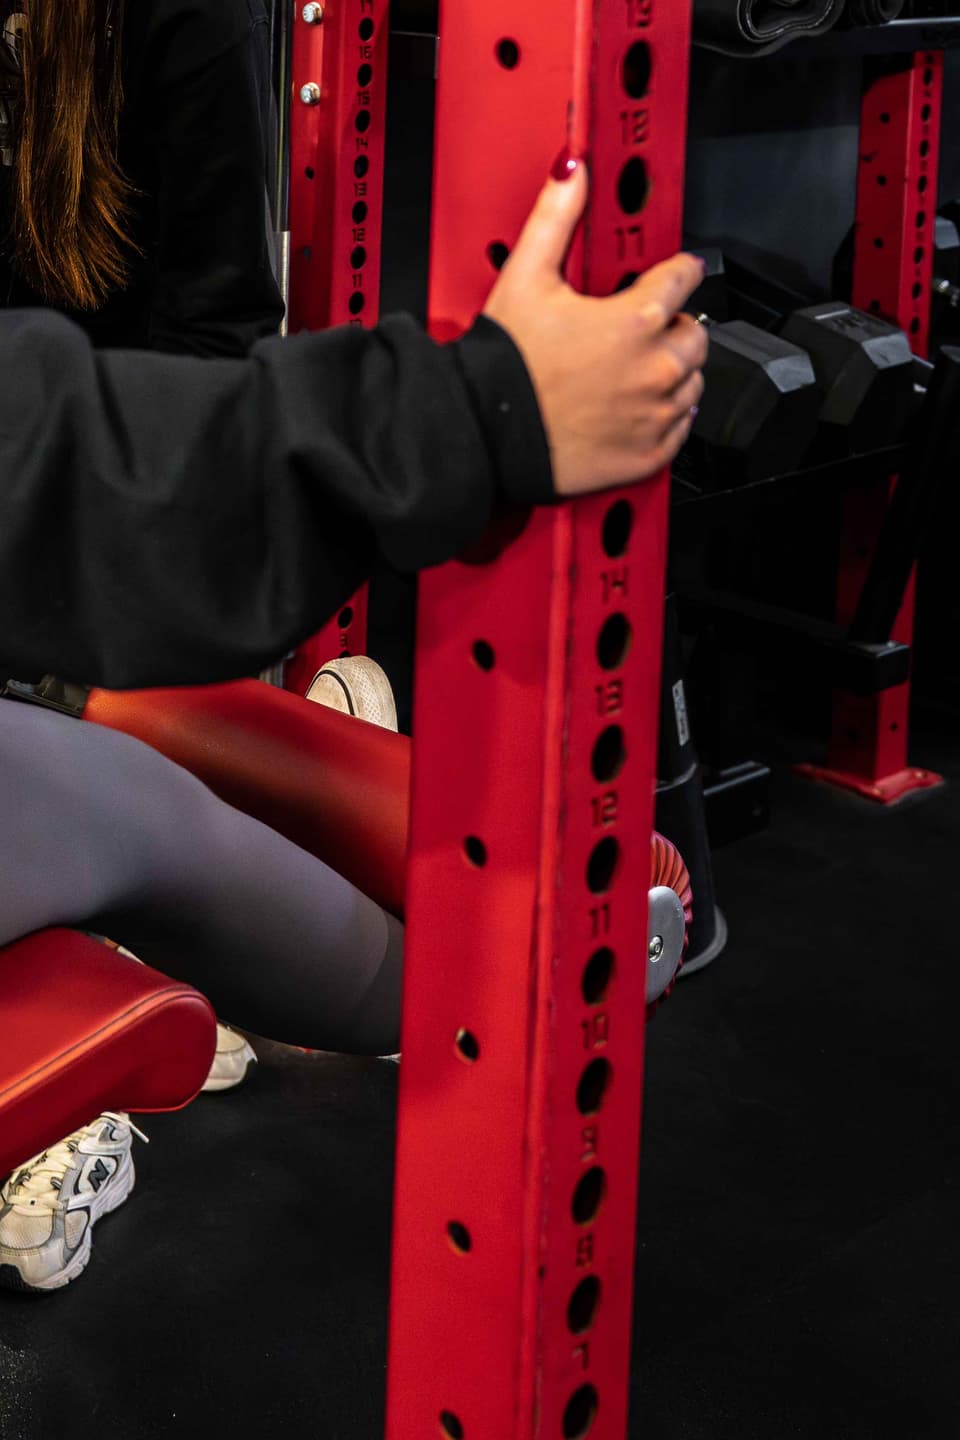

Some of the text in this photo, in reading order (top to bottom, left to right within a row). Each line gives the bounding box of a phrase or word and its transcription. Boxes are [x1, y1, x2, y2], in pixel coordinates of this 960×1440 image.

[614, 224, 644, 260] 17
[600, 566, 630, 604] 14
[595, 677, 624, 716] 13
[590, 790, 619, 826] 12
[588, 901, 611, 939] 11
[580, 1011, 610, 1051] 10
[87, 1158, 109, 1193] N
